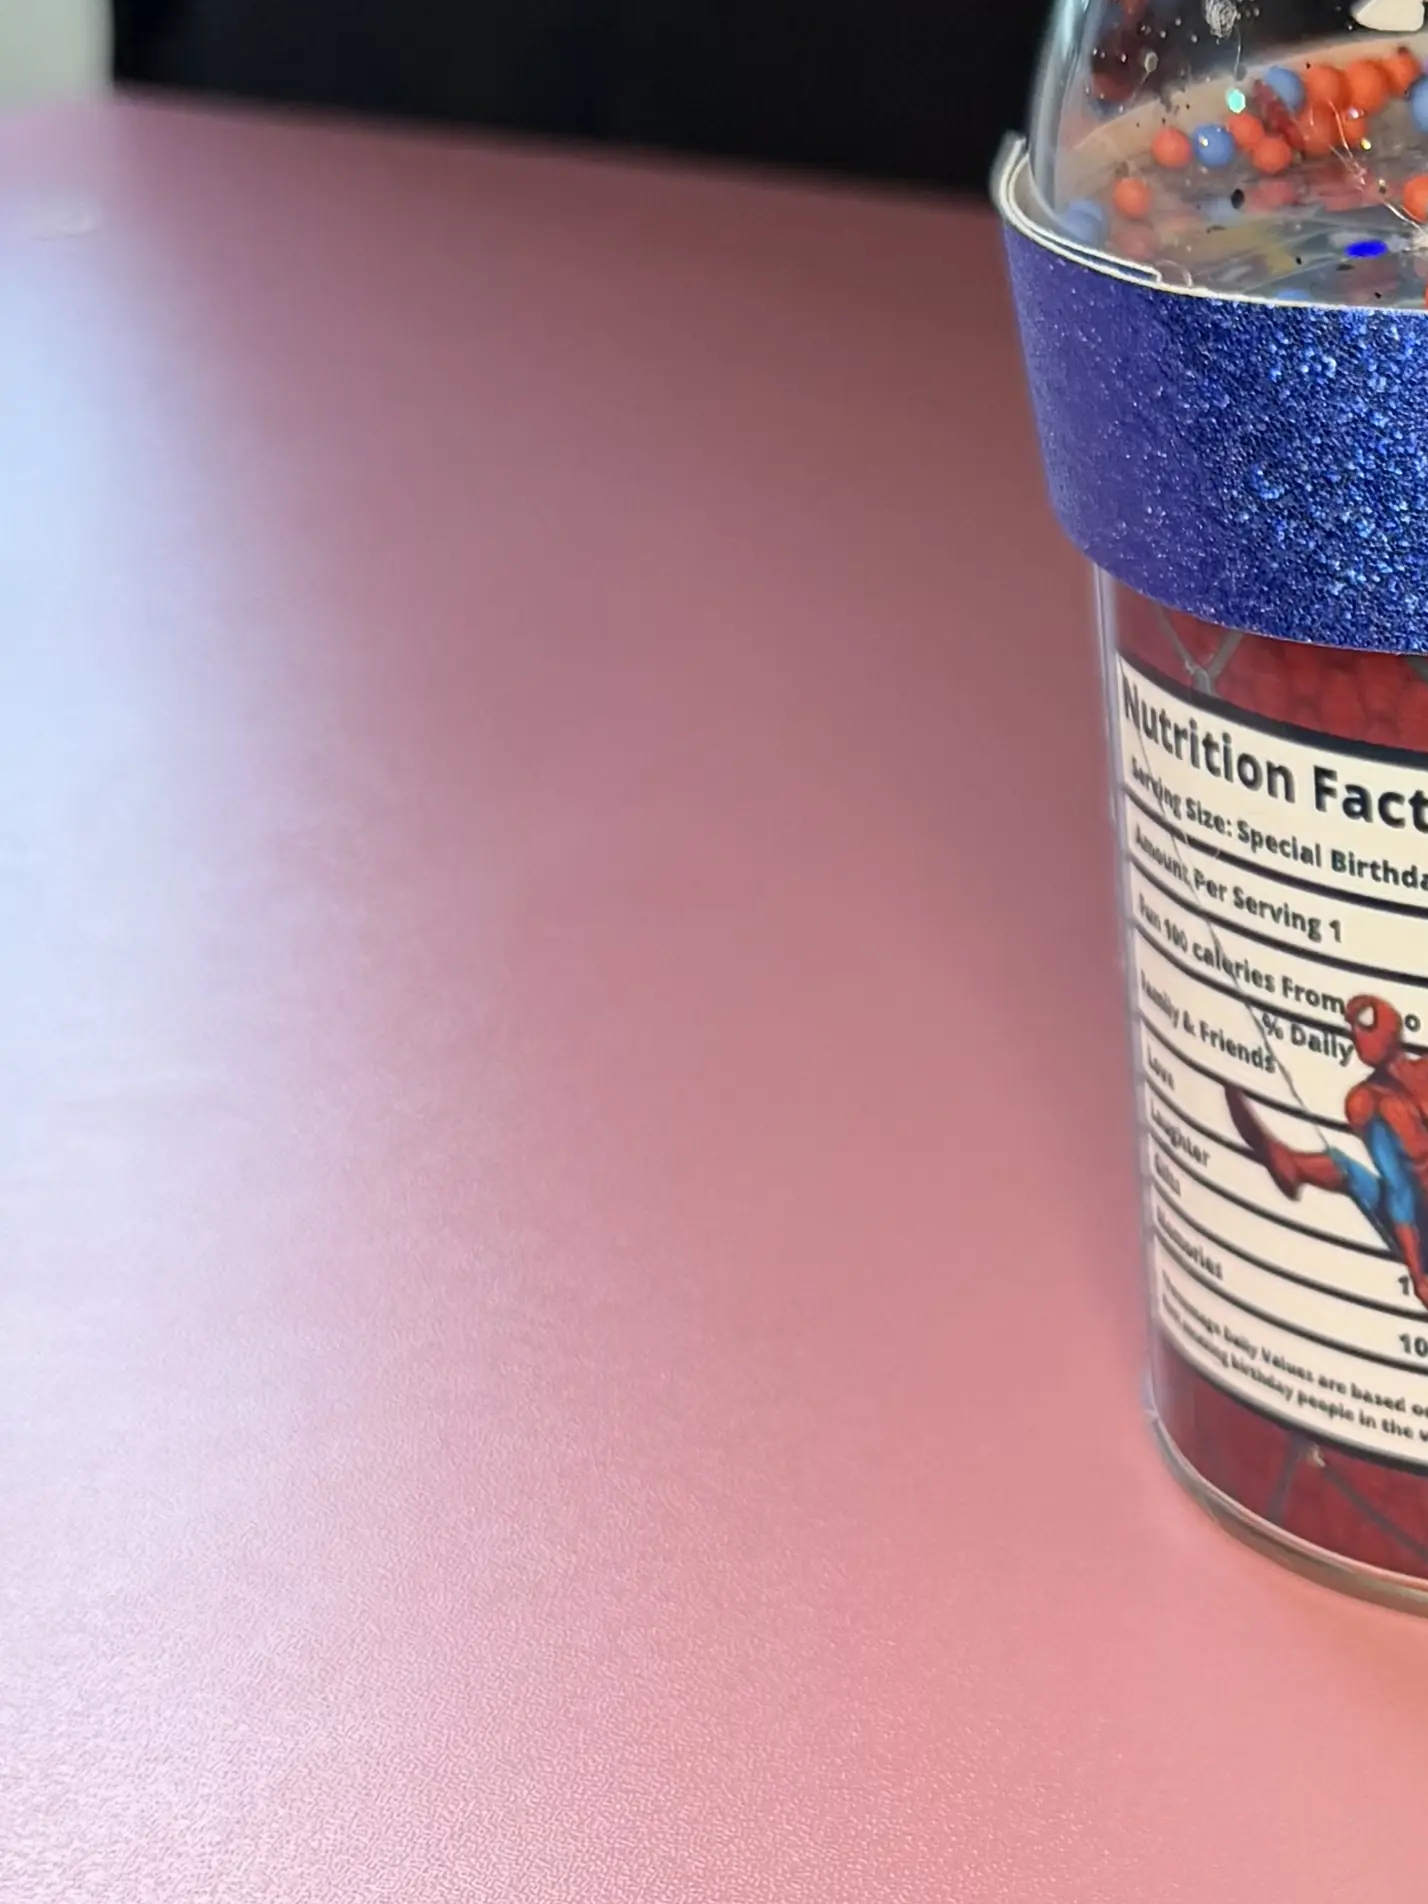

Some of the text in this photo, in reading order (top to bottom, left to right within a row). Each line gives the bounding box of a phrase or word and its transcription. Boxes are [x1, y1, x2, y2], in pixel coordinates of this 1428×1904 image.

[1123, 673, 1296, 804] Nutrition
[1132, 756, 1181, 820] Serving
[1186, 797, 1233, 838] Size:
[1237, 818, 1322, 868] Special
[1193, 867, 1228, 903] Per
[1233, 884, 1322, 943] Serving
[1329, 918, 1342, 943] 1
[1192, 942, 1276, 994] calories
[1282, 973, 1348, 1016] From
[1183, 1009, 1196, 1038] &
[1199, 1019, 1277, 1074] Friends
[1261, 1012, 1354, 1067] % Daily
[1297, 1388, 1356, 1424] people
[1358, 1408, 1377, 1429] in
[1380, 1416, 1415, 1440] the
[1317, 1373, 1347, 1397] are
[1350, 1382, 1406, 1414] based
